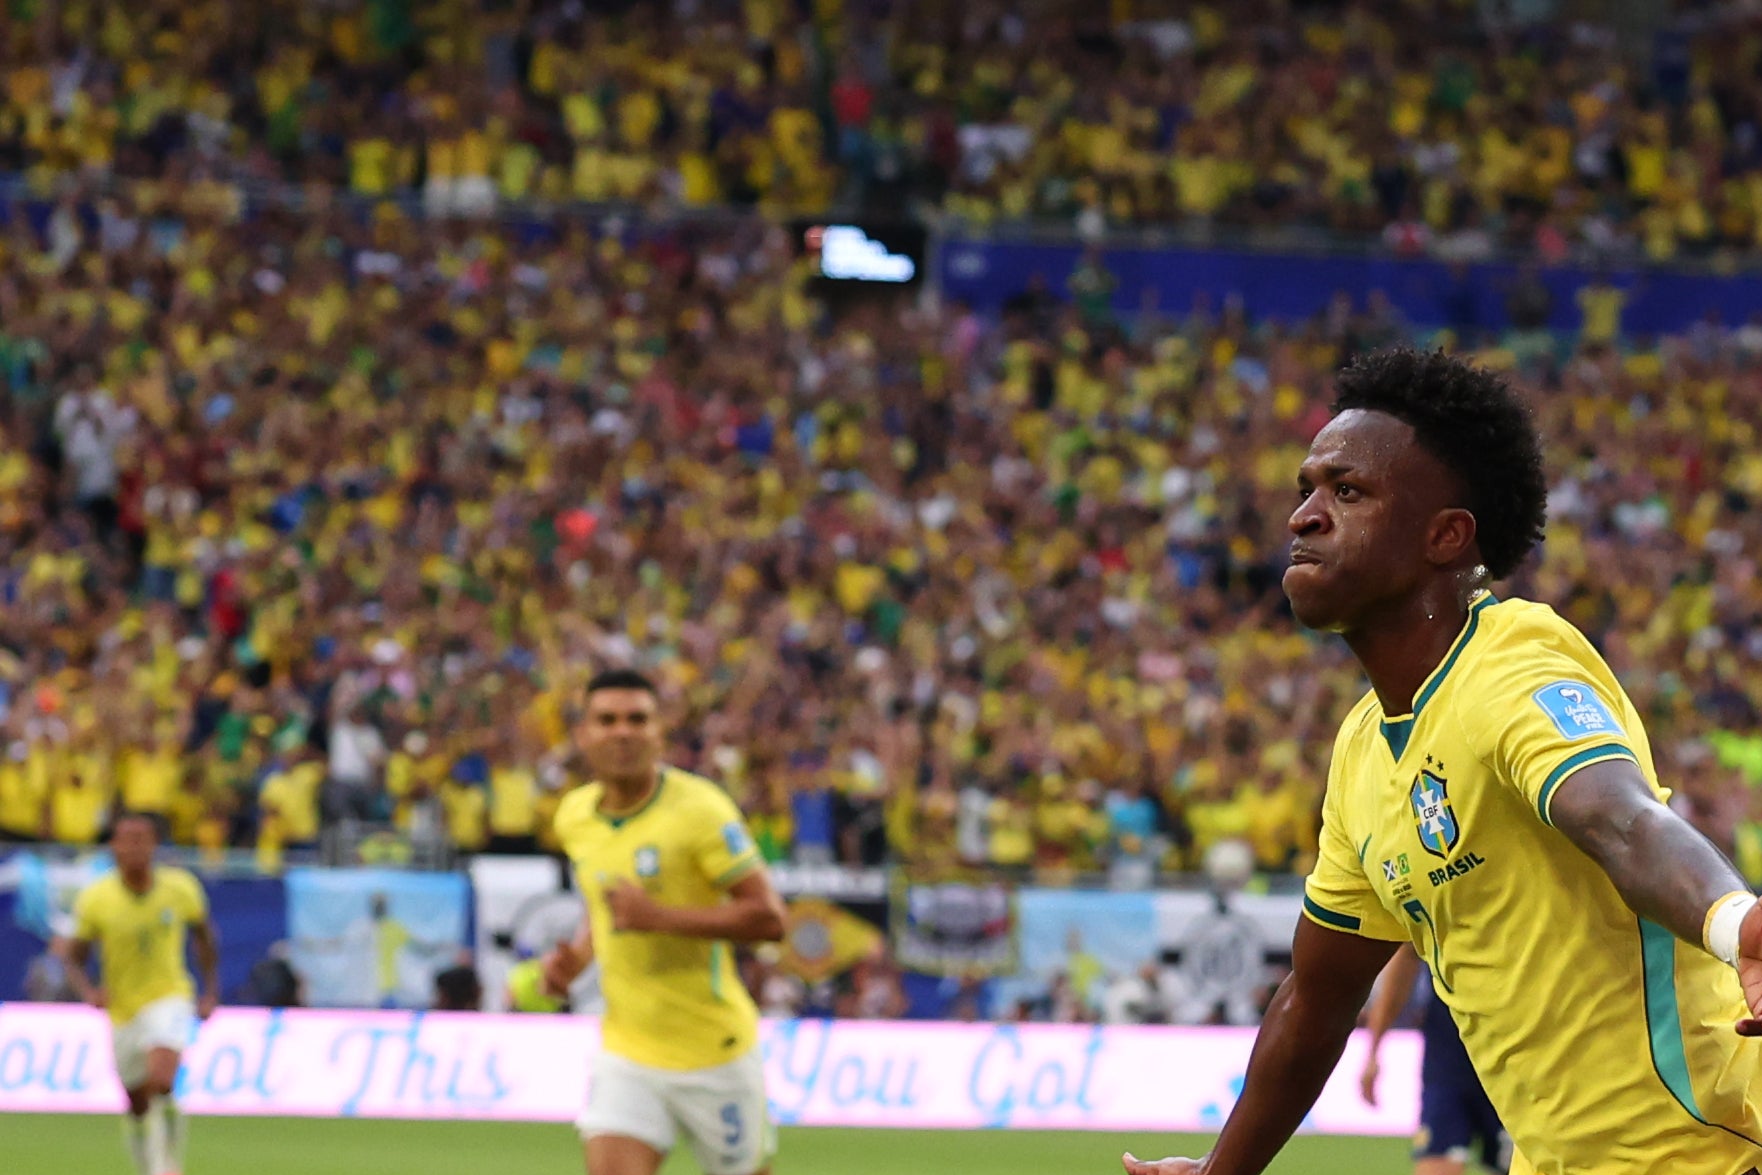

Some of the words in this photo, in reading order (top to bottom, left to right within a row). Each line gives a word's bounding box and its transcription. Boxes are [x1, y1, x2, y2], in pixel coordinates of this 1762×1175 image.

[1423, 804, 1438, 820] CBF
[1427, 852, 1486, 887] BRASIL
[1402, 898, 1455, 995] 7
[0, 1037, 91, 1092] ou
[329, 1009, 510, 1118] This
[754, 1018, 918, 1124] You
[967, 1023, 1105, 1128] Got
